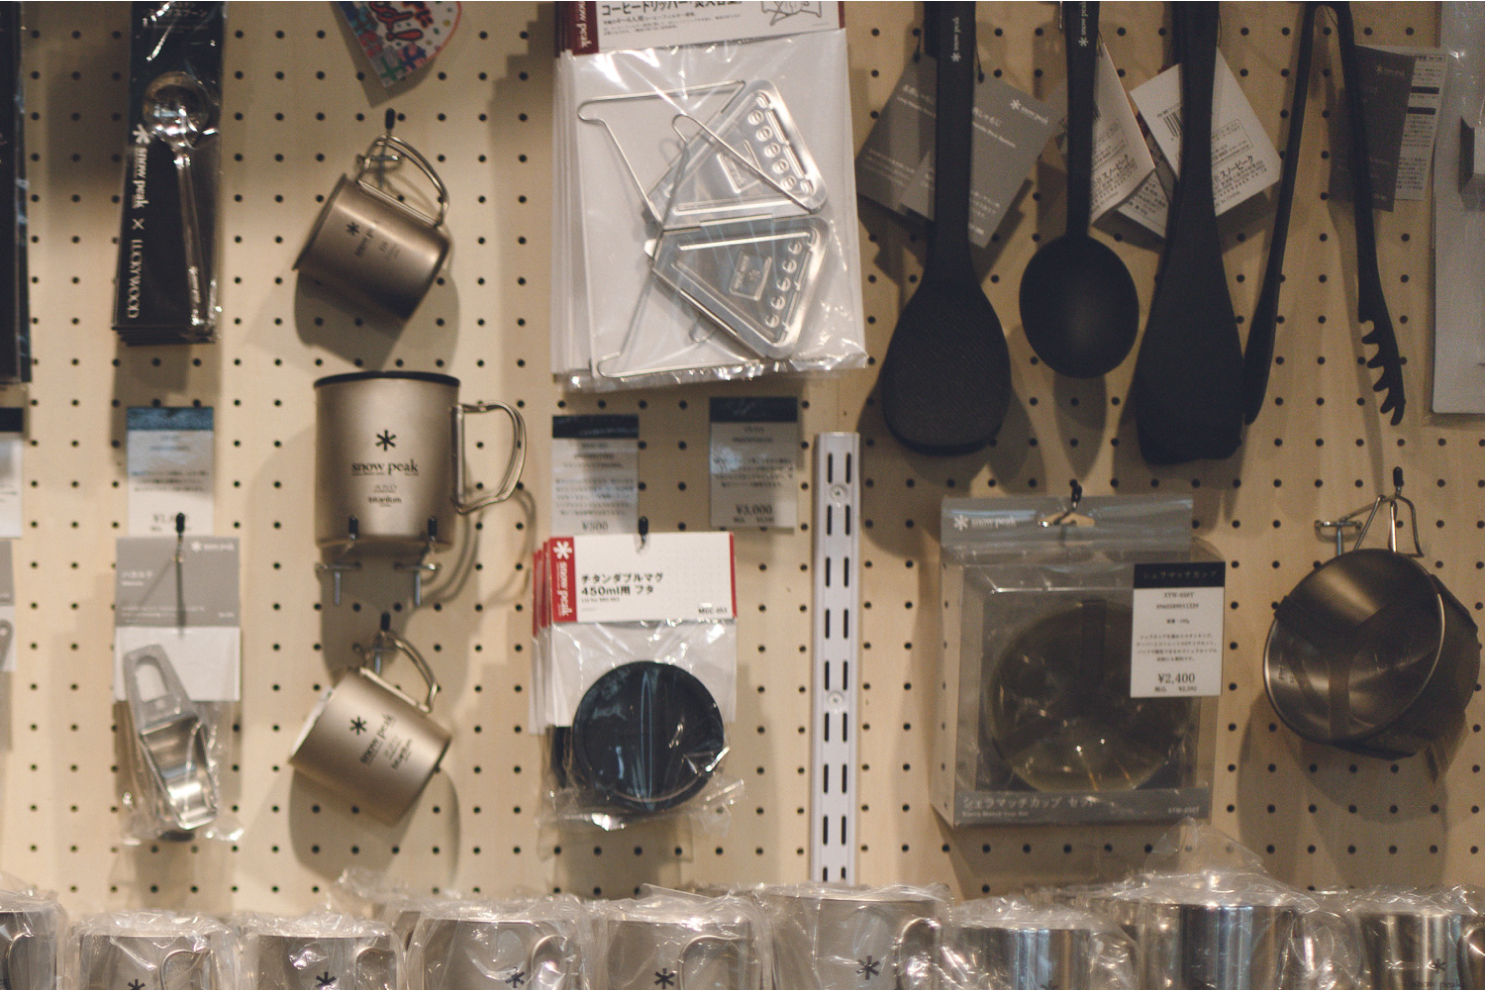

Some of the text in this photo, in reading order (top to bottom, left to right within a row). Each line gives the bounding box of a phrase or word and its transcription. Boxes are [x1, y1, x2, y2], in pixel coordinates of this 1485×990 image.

[351, 458, 419, 476] snow peak
[581, 571, 664, 584] チタンダブルマグ
[581, 585, 655, 597] 450ml用 フタ
[1157, 672, 1196, 684] ¥2,400
